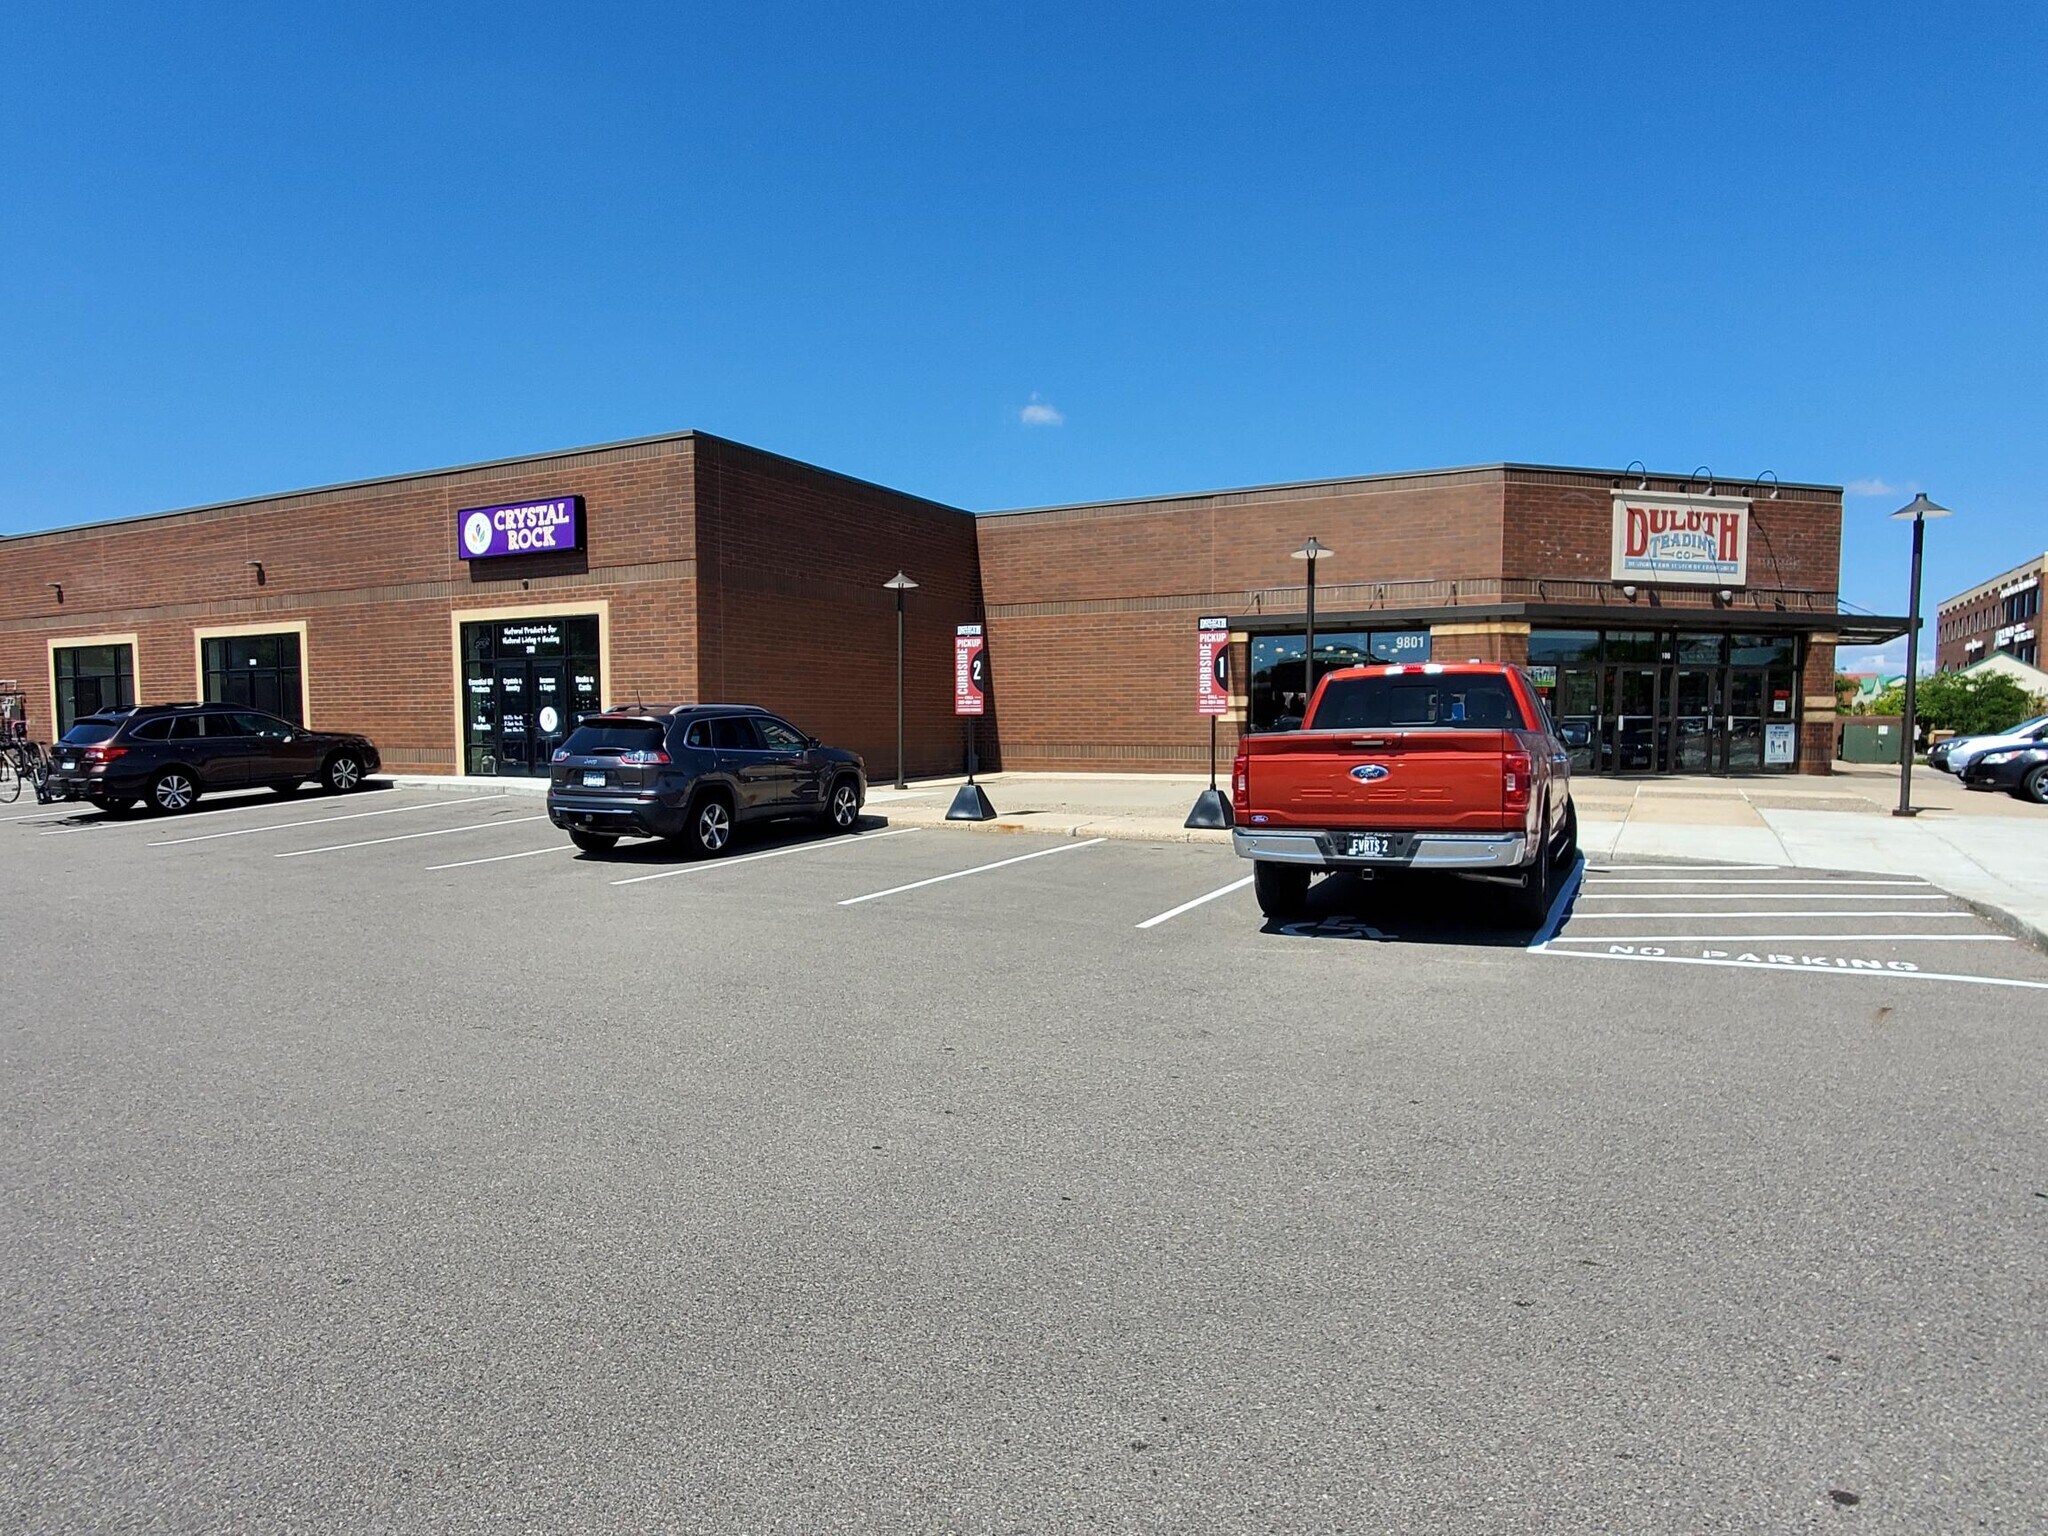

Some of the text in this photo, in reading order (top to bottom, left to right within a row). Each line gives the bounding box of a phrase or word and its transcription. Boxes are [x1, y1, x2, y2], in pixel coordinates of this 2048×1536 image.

[494, 503, 570, 531] CRYSTAL
[507, 526, 556, 550] ROCK
[1625, 507, 1740, 562] DULUTH
[1650, 533, 1718, 562] TRADING
[1675, 551, 1691, 560] CO
[957, 638, 981, 648] PICKUP
[1199, 632, 1227, 643] PICKUP
[1396, 636, 1424, 649] 9801
[957, 648, 969, 695] CURBSIDE
[973, 660, 981, 680] 2
[1199, 643, 1212, 694] CURBSIDE
[1218, 656, 1225, 678] 1
[1352, 839, 1389, 852] EVRTS 2
[1609, 945, 1919, 971] NO PARKING
